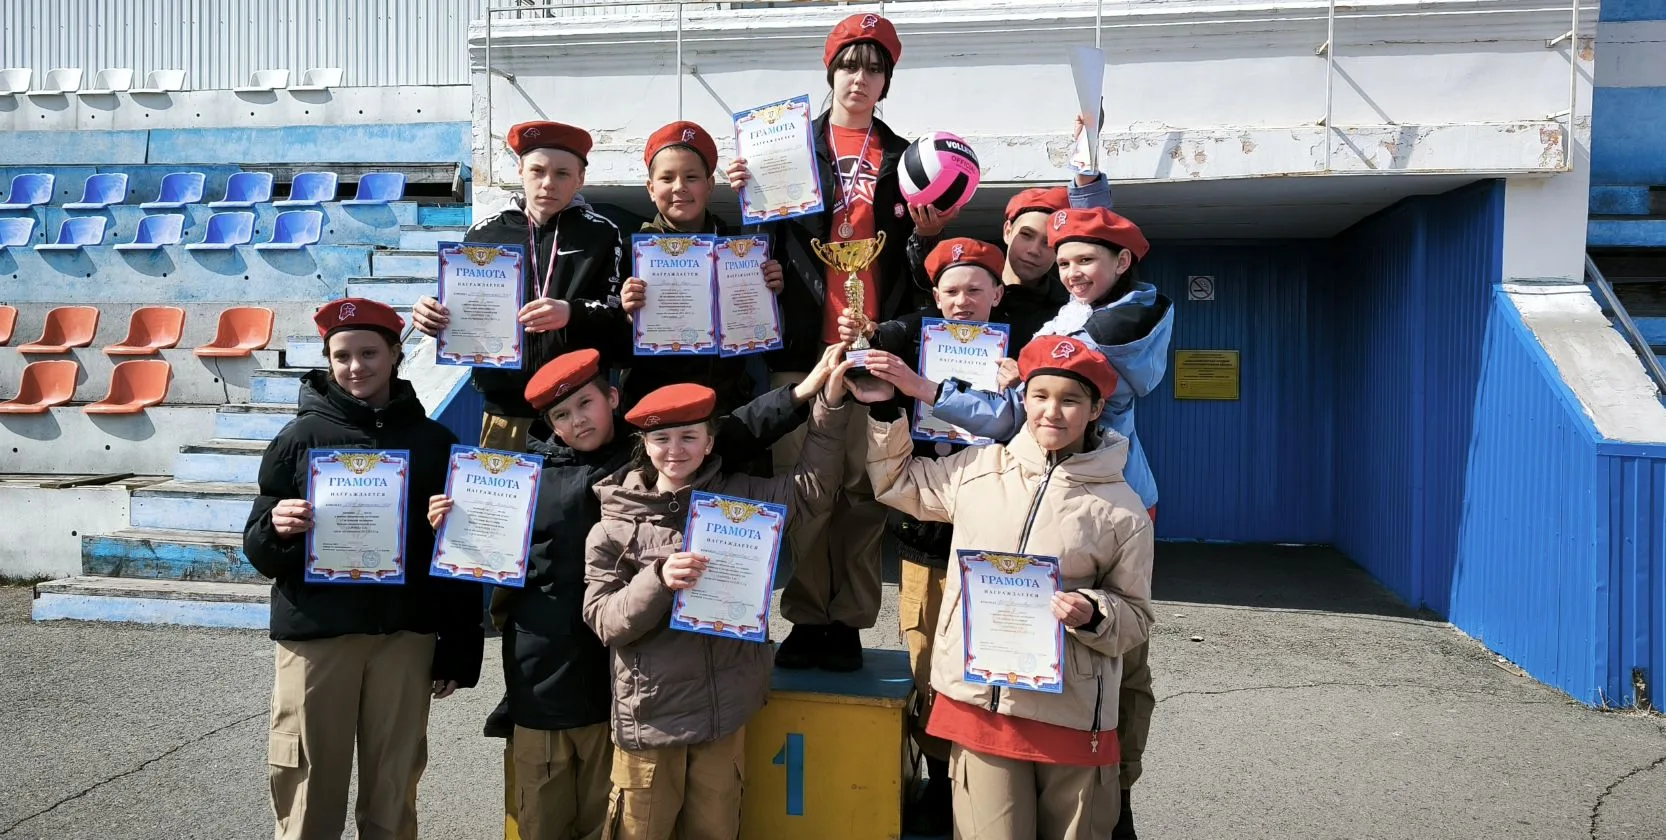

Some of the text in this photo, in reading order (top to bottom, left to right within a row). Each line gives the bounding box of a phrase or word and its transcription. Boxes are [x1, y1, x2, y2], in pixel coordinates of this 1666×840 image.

[750, 122, 795, 140] ГРАМОТА
[650, 259, 700, 268] ГРАМОТА
[725, 259, 759, 270] ГРАМОТА
[456, 267, 506, 279] ГРАМОТА
[937, 344, 988, 357] ГРАМОТА
[329, 477, 387, 487] ГРАМОТА
[466, 473, 520, 489] ГРАМОТА
[706, 522, 761, 540] ГРАМОТА
[706, 537, 759, 550] НАГРАЖДАЕТСЯ
[980, 574, 1040, 588] ГРАМОТА
[984, 589, 1039, 598] НАГРАЖДАЕТСЯ
[772, 732, 804, 816] 1
